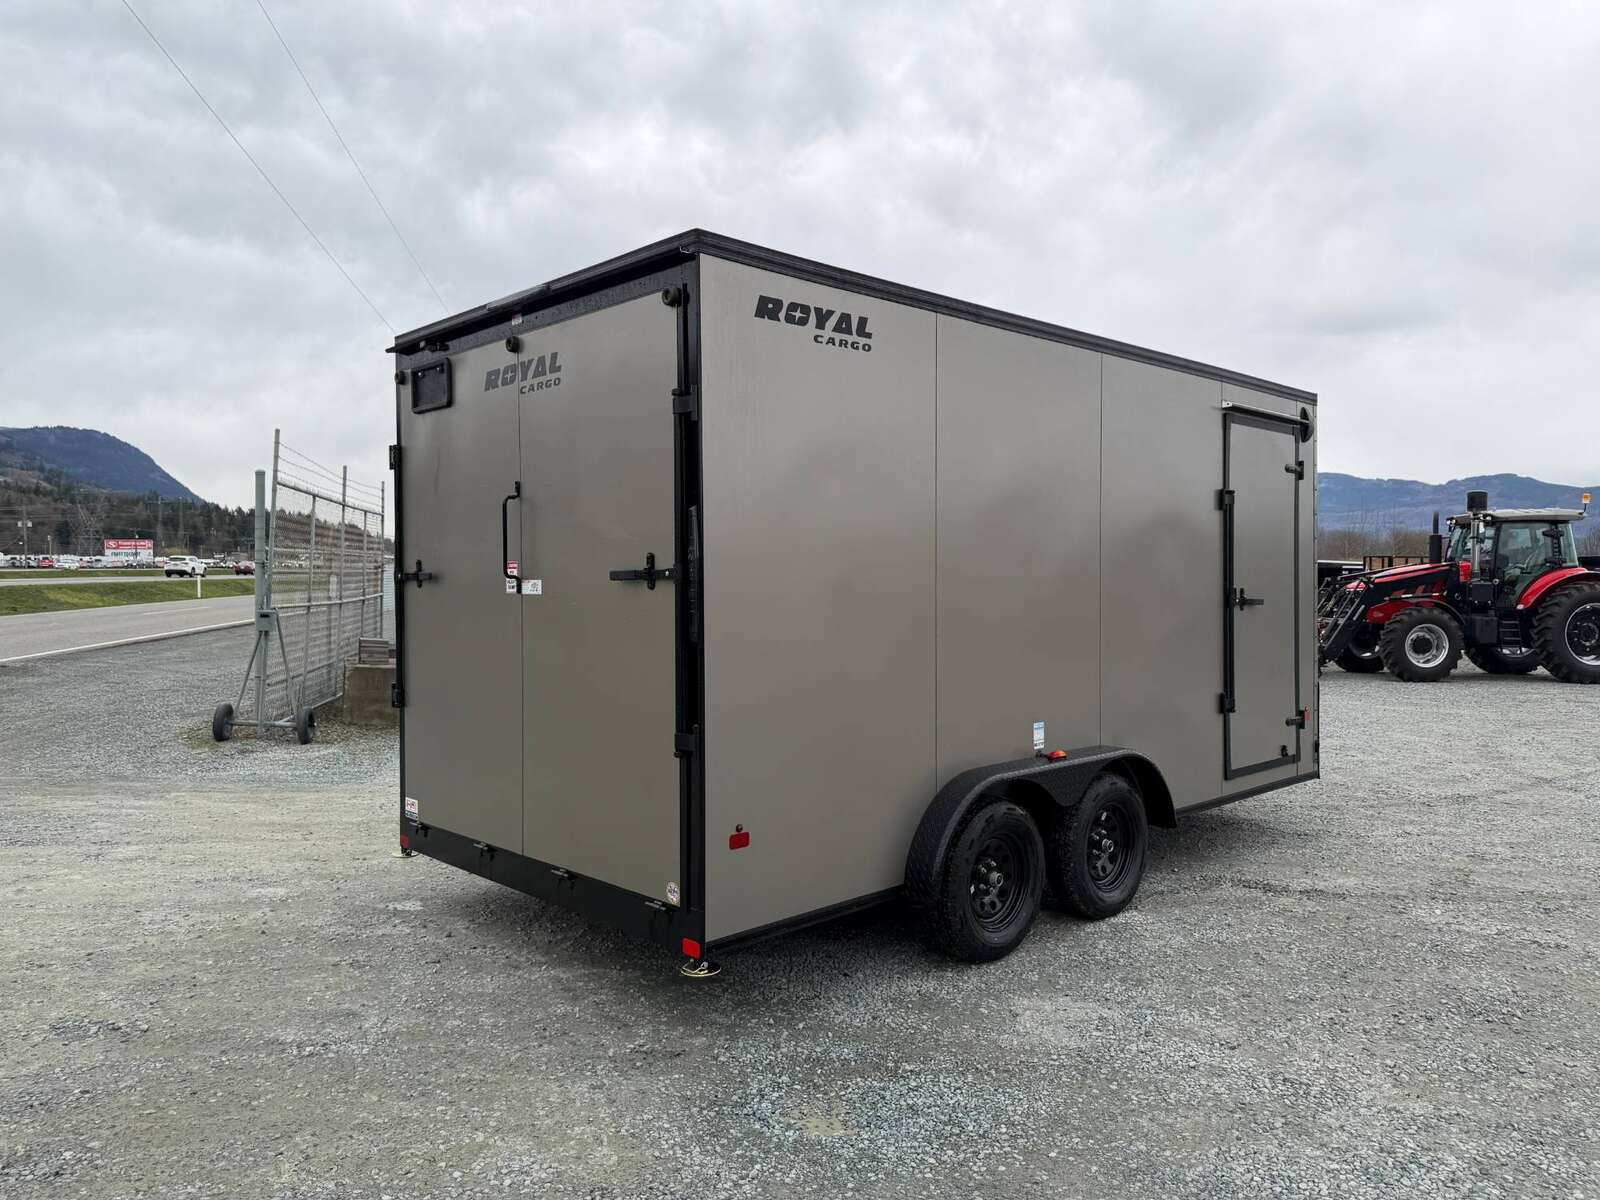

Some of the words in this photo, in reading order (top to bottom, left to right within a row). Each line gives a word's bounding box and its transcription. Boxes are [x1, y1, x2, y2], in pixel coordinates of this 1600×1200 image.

[754, 295, 872, 339] ROYAL
[813, 335, 872, 352] CARGO
[484, 352, 562, 392] ROYAL
[520, 377, 561, 394] CARGO
